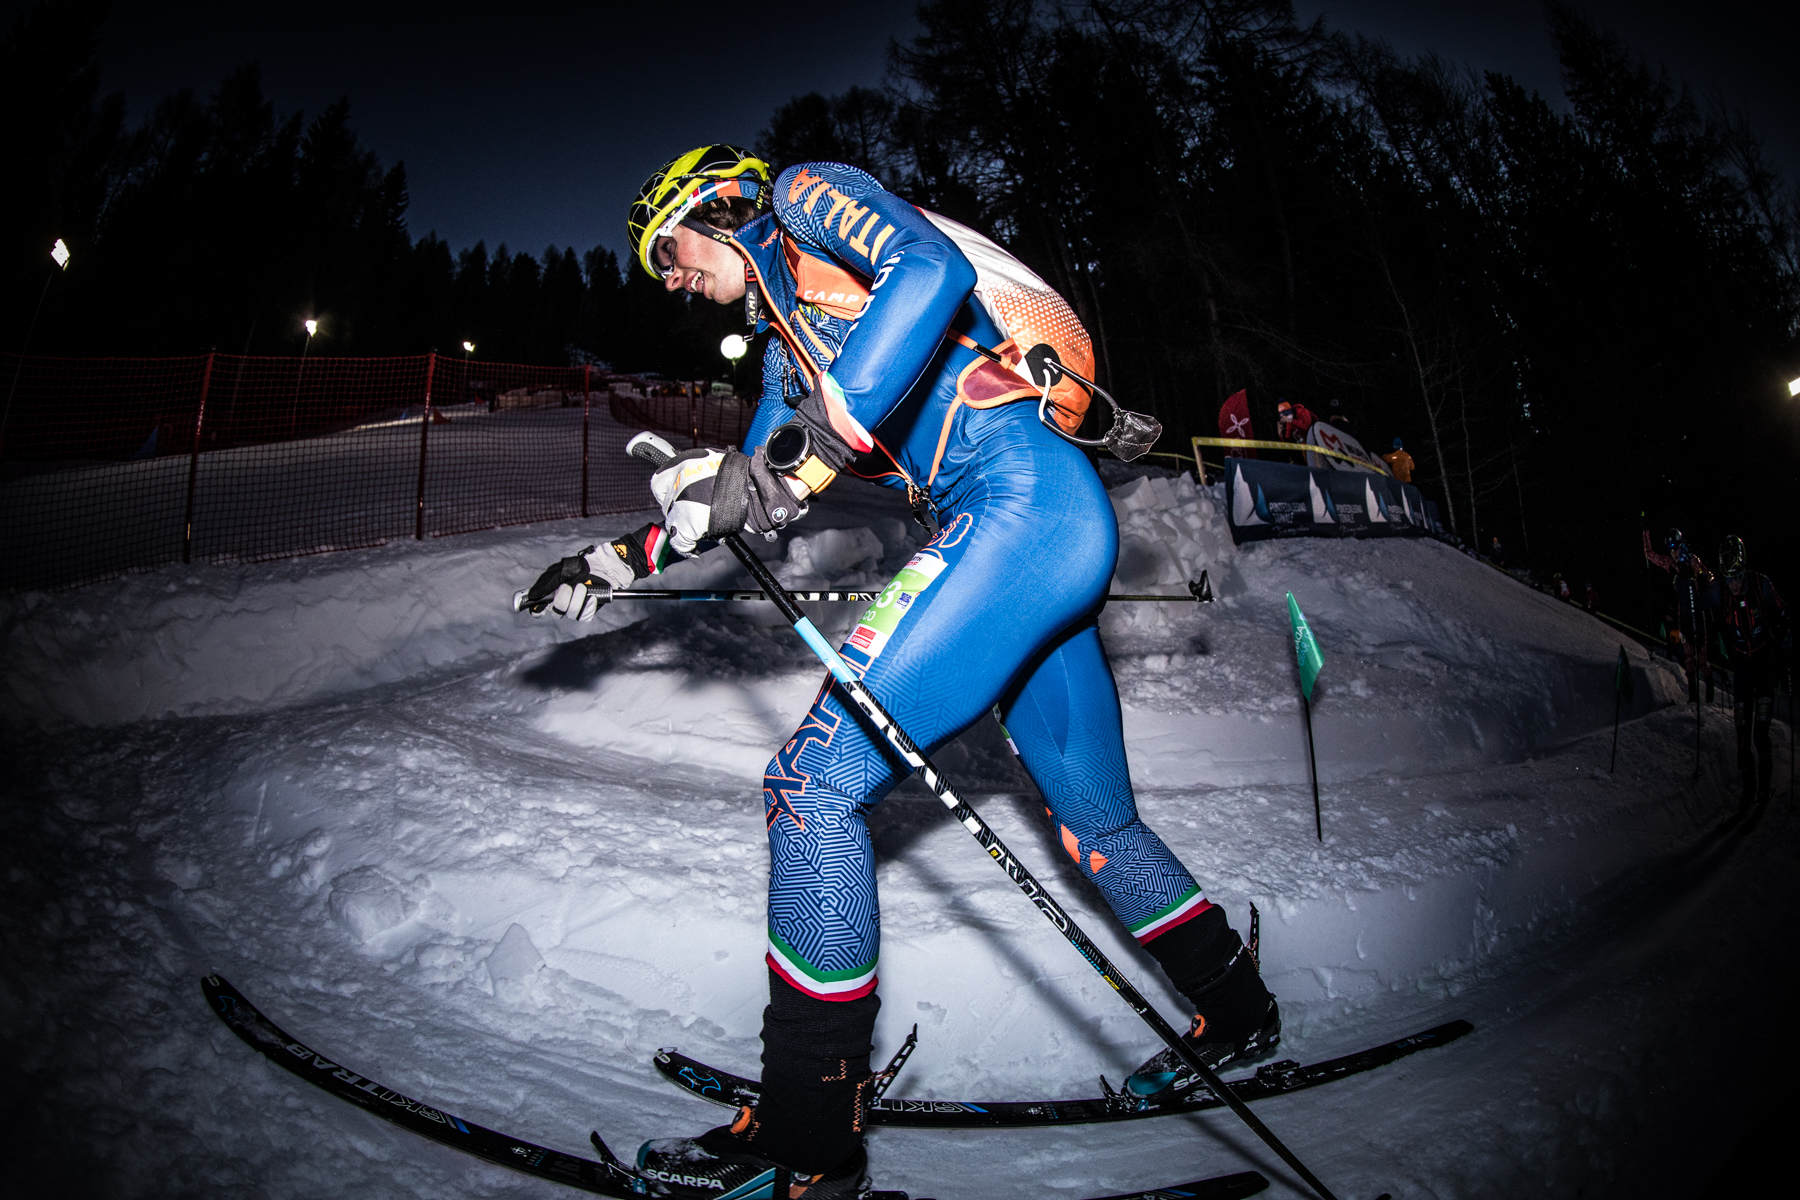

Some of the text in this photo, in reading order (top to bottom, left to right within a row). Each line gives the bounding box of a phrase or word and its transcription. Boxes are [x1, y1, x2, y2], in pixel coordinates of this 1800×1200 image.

[756, 185, 766, 210] CAMP
[788, 168, 896, 266] ITALIA
[748, 291, 757, 325] CAMP
[803, 289, 860, 304] CAMP
[645, 1168, 726, 1191] SCARPA
